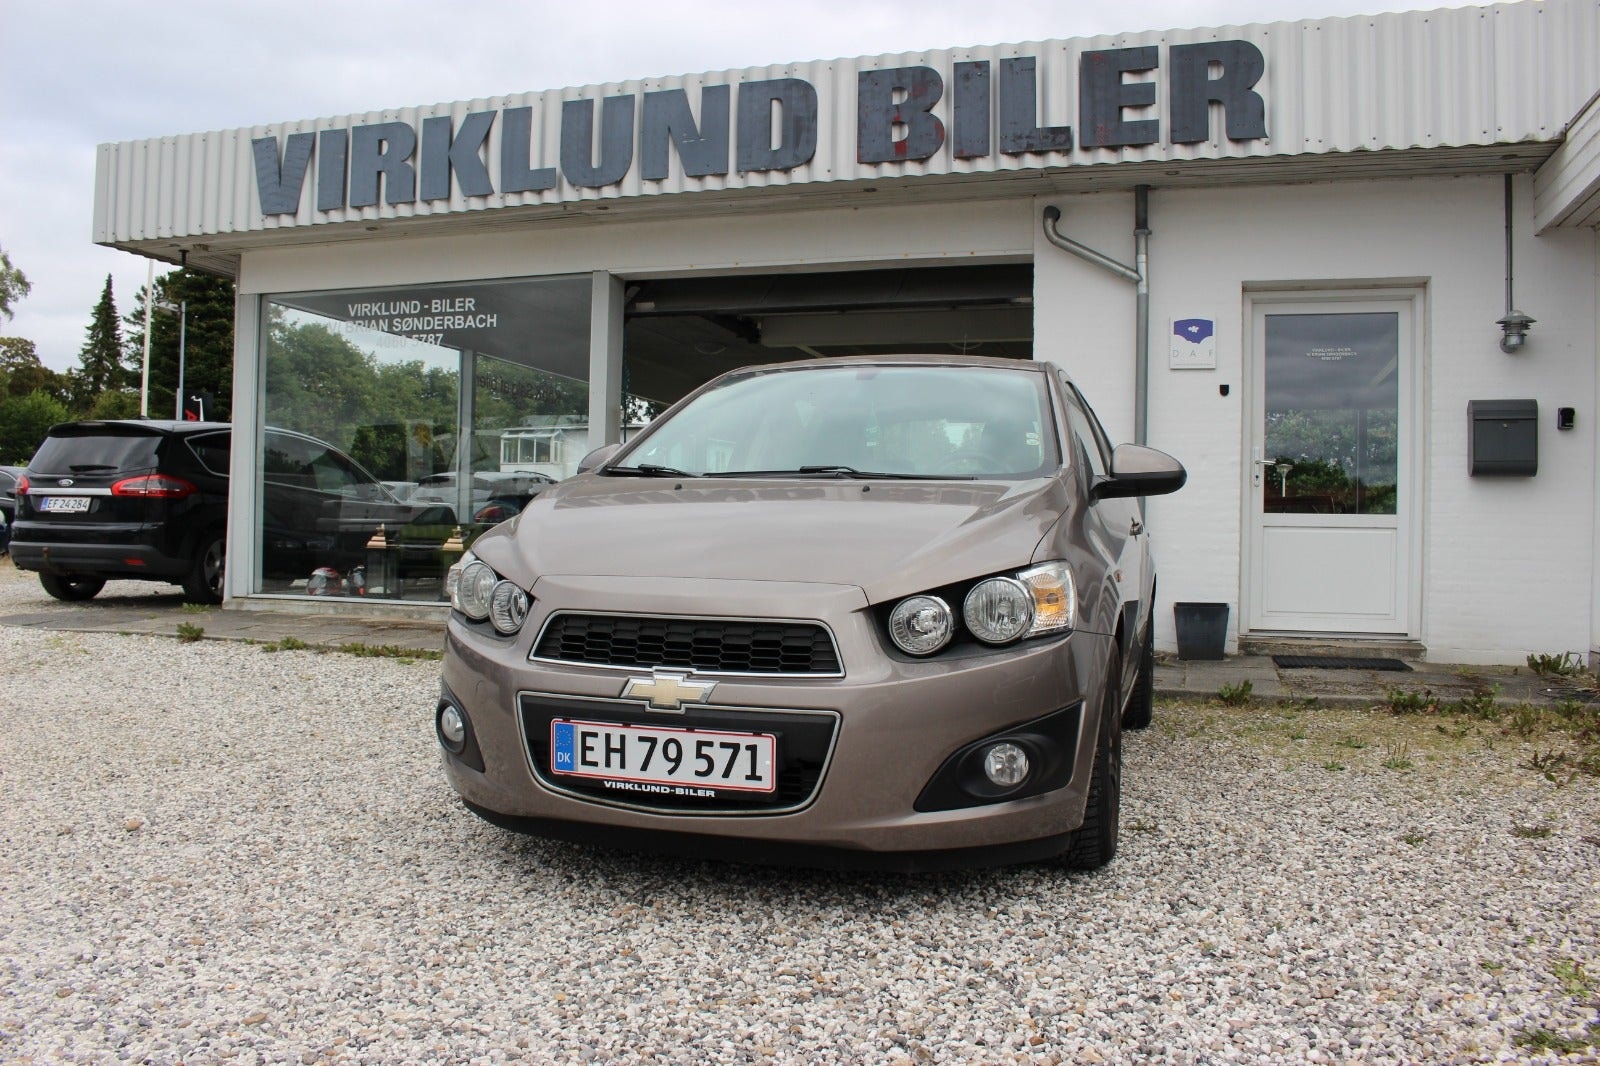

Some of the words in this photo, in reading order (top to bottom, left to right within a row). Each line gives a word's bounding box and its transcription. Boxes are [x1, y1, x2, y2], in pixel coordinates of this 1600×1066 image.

[251, 77, 818, 215] VIRKLUND
[857, 39, 1269, 164] BILER
[348, 300, 421, 317] VIRKLUND
[431, 298, 476, 313] BILER
[345, 318, 388, 333] BRIAN
[392, 314, 498, 332] SØNDERBACH
[557, 751, 571, 764] DK
[580, 730, 626, 770] EH
[637, 735, 683, 776] 79
[694, 739, 763, 782] 571
[603, 780, 716, 798] VIRKLUND-BILER
